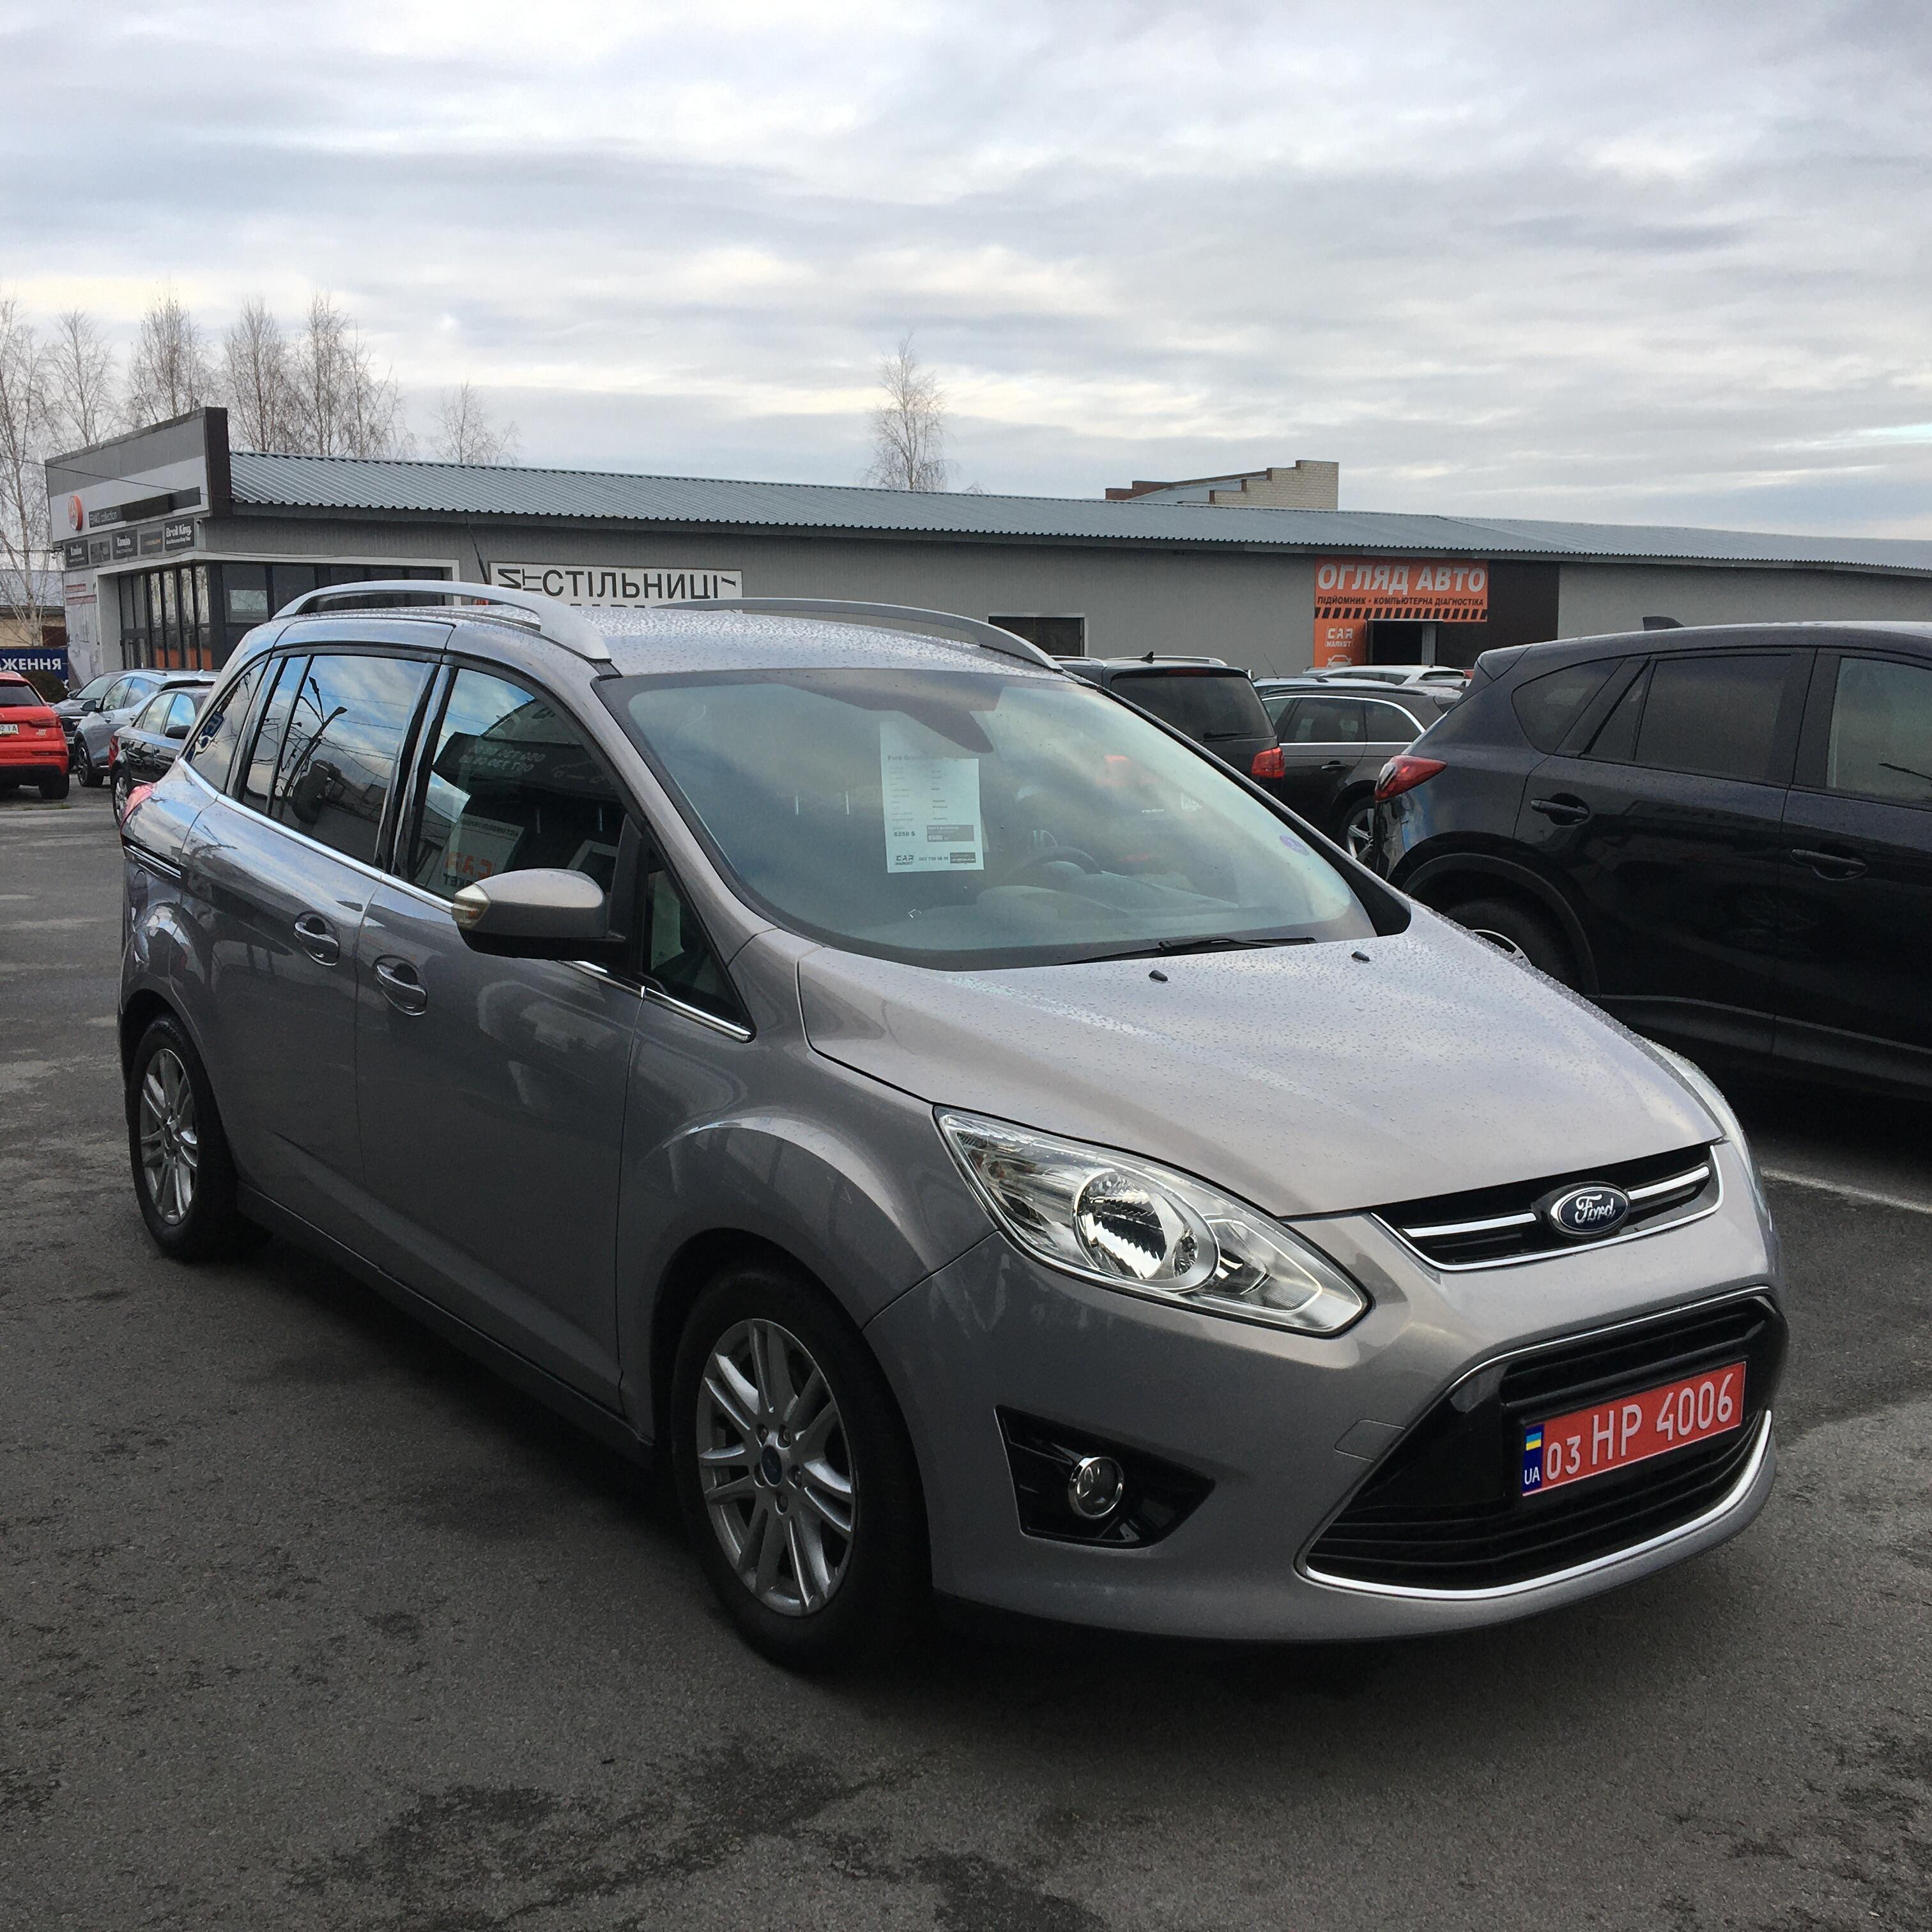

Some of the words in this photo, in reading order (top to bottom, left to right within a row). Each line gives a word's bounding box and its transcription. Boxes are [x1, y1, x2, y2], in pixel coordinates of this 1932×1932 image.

[542, 569, 718, 599] СТІЛЬНИЦІ
[1318, 564, 1409, 595] ОГЛЯД
[1416, 566, 1485, 593] АВТО
[1317, 595, 1366, 606] ПІДЙОМНИК
[1328, 628, 1353, 639] CAR
[0, 658, 61, 670] ЖЕННЯ
[1575, 1193, 1616, 1224] Ford
[1524, 1466, 1540, 1485] UA
[1547, 1435, 1581, 1480] 03
[1592, 1404, 1642, 1465] HP
[1656, 1374, 1733, 1441] 4006
